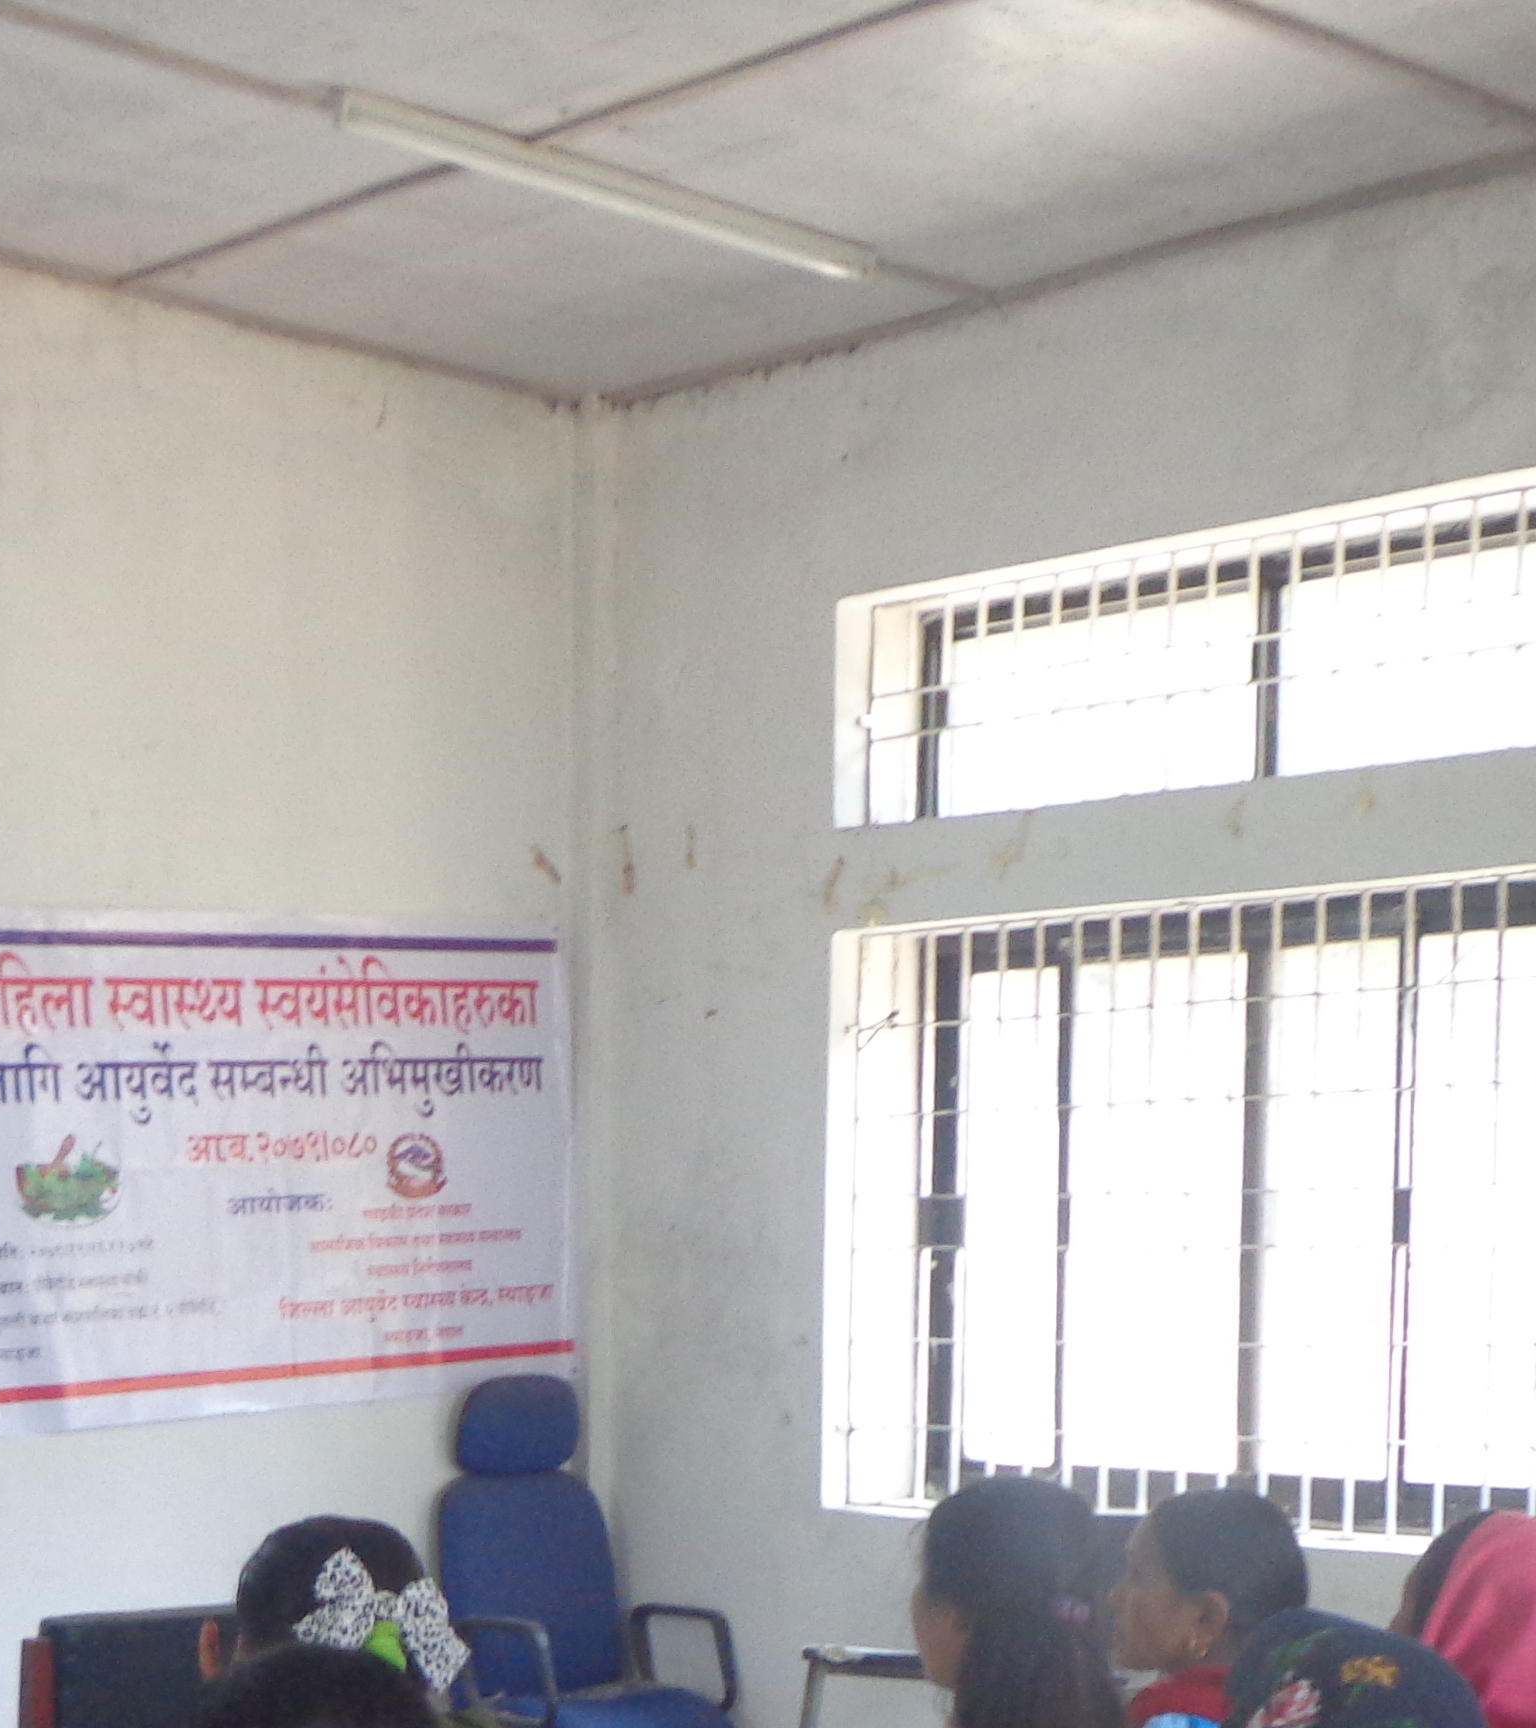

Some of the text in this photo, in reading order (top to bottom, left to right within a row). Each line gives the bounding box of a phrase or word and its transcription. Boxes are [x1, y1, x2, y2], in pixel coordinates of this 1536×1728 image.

[104, 976, 244, 1031] स्वास्थ्य
[75, 1040, 198, 1125] आयुर्वेद
[341, 1039, 544, 1117] अभिमुखीकरण
